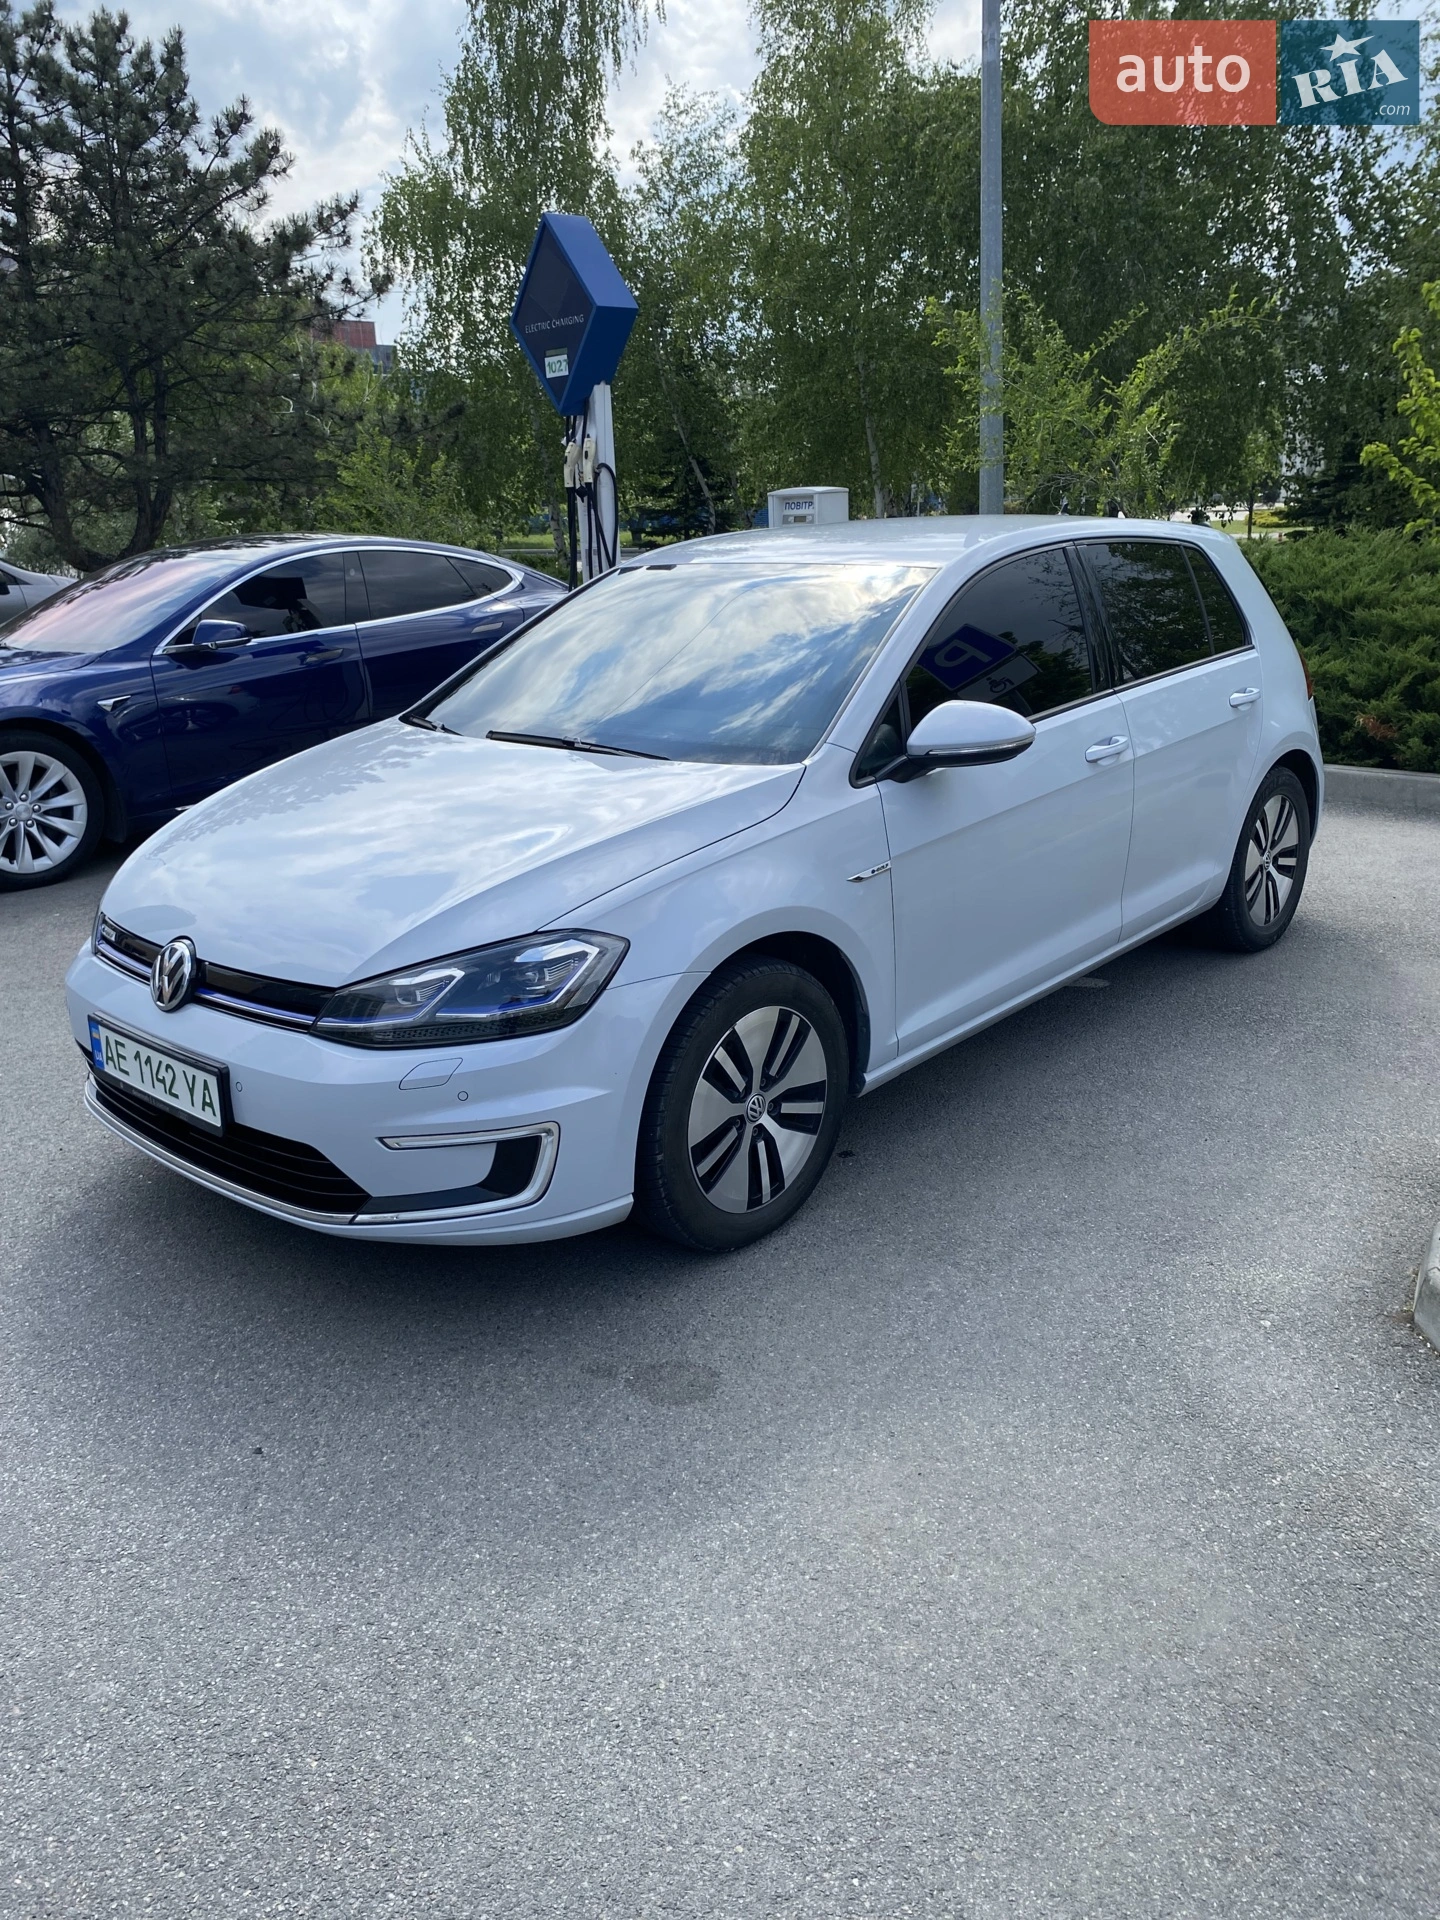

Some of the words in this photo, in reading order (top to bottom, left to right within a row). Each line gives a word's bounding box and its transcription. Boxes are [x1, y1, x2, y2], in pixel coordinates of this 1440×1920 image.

[525, 320, 551, 334] ELECTRIC
[551, 314, 585, 329] CHARGING
[547, 358, 569, 374] 1027
[784, 501, 815, 511] ПОВІТР
[105, 1034, 130, 1077] AE
[133, 1050, 180, 1100] 1142
[182, 1069, 217, 1118] YA
